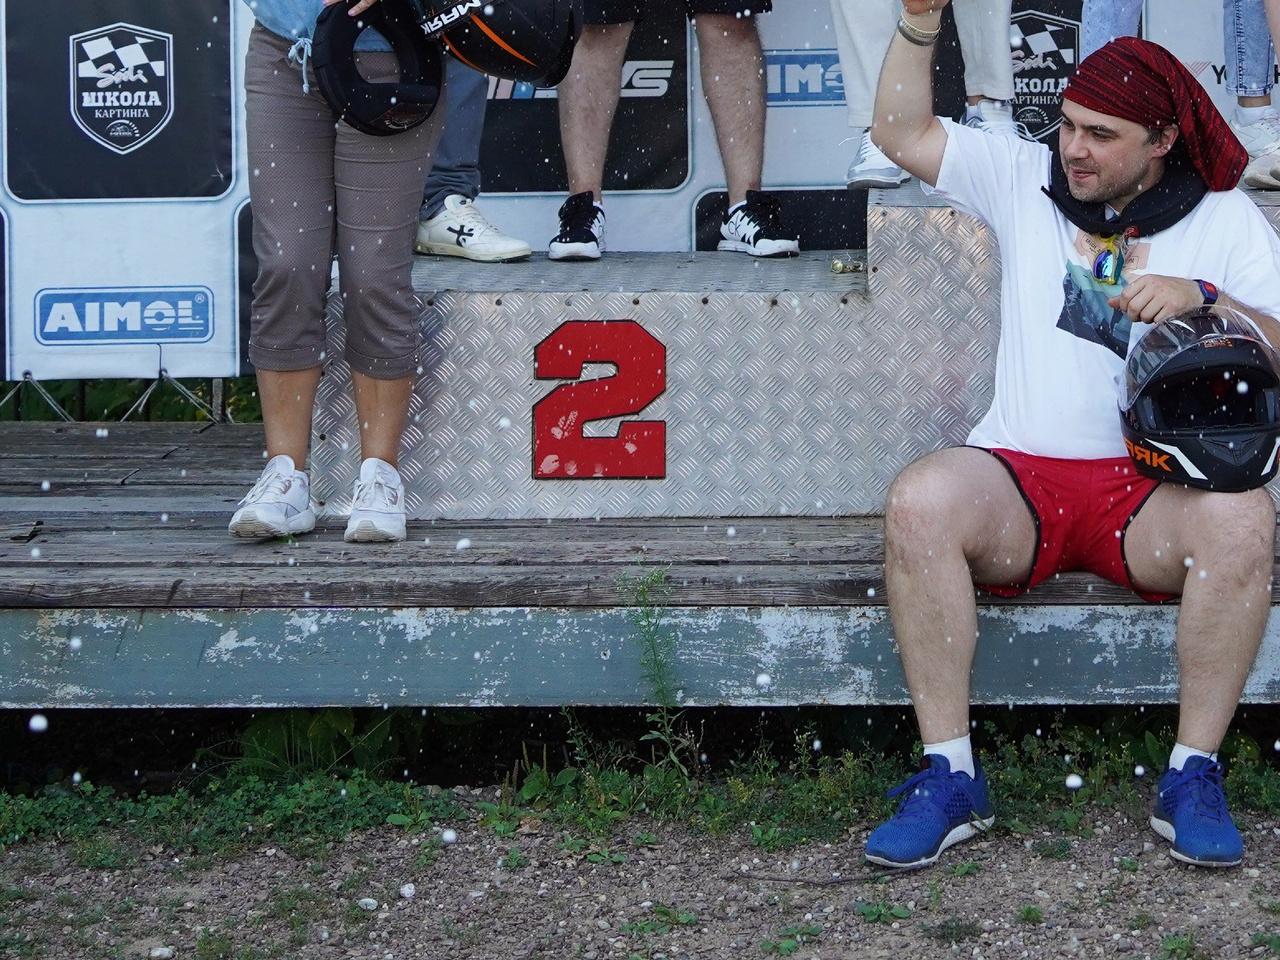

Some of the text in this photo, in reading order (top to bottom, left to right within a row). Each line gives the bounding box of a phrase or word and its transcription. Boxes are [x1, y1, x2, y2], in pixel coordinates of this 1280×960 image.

[82, 91, 162, 107] ШКОЛА
[95, 109, 150, 118] КАРТИНГА
[43, 301, 205, 332] AIMOL
[533, 320, 667, 480] 2
